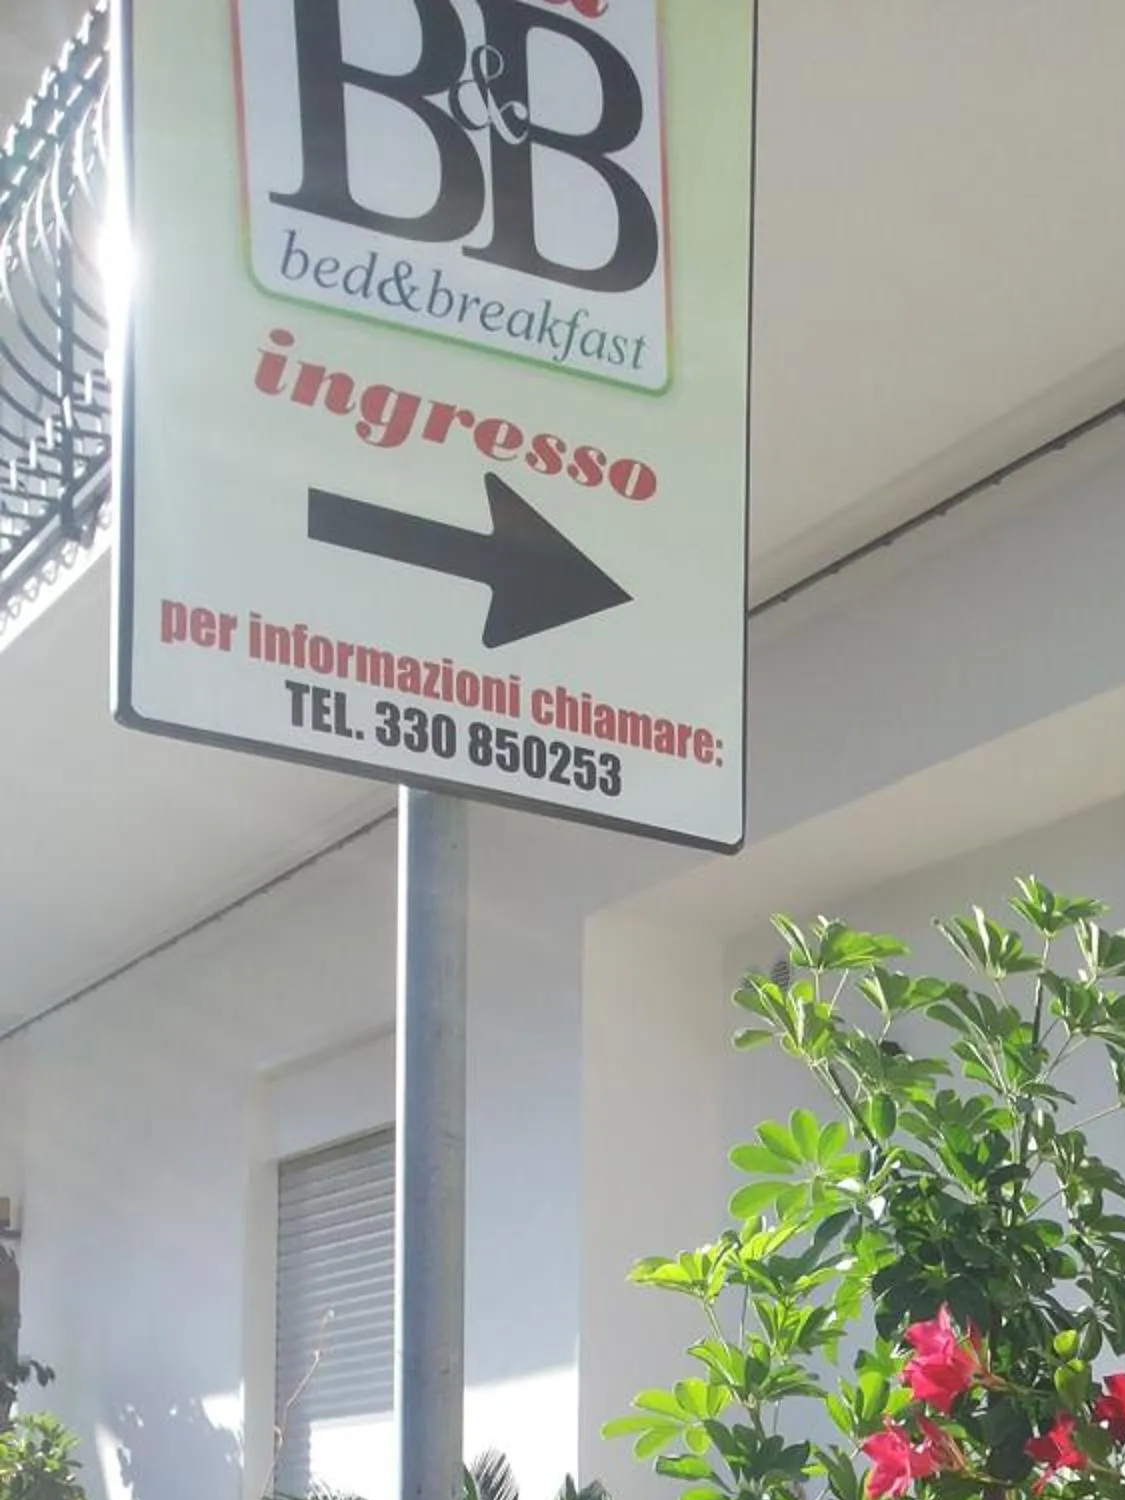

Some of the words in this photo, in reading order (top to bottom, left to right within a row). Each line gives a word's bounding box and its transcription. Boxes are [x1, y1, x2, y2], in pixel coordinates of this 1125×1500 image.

[268, 0, 660, 293] B&B
[280, 229, 648, 370] bed&breakfast
[253, 329, 658, 501] ingresso
[160, 599, 237, 653] per
[248, 612, 522, 720] informazioni
[530, 687, 724, 767] chiamare:
[284, 680, 364, 740] TEL.
[374, 700, 457, 760] 330
[467, 721, 622, 797] 850253
